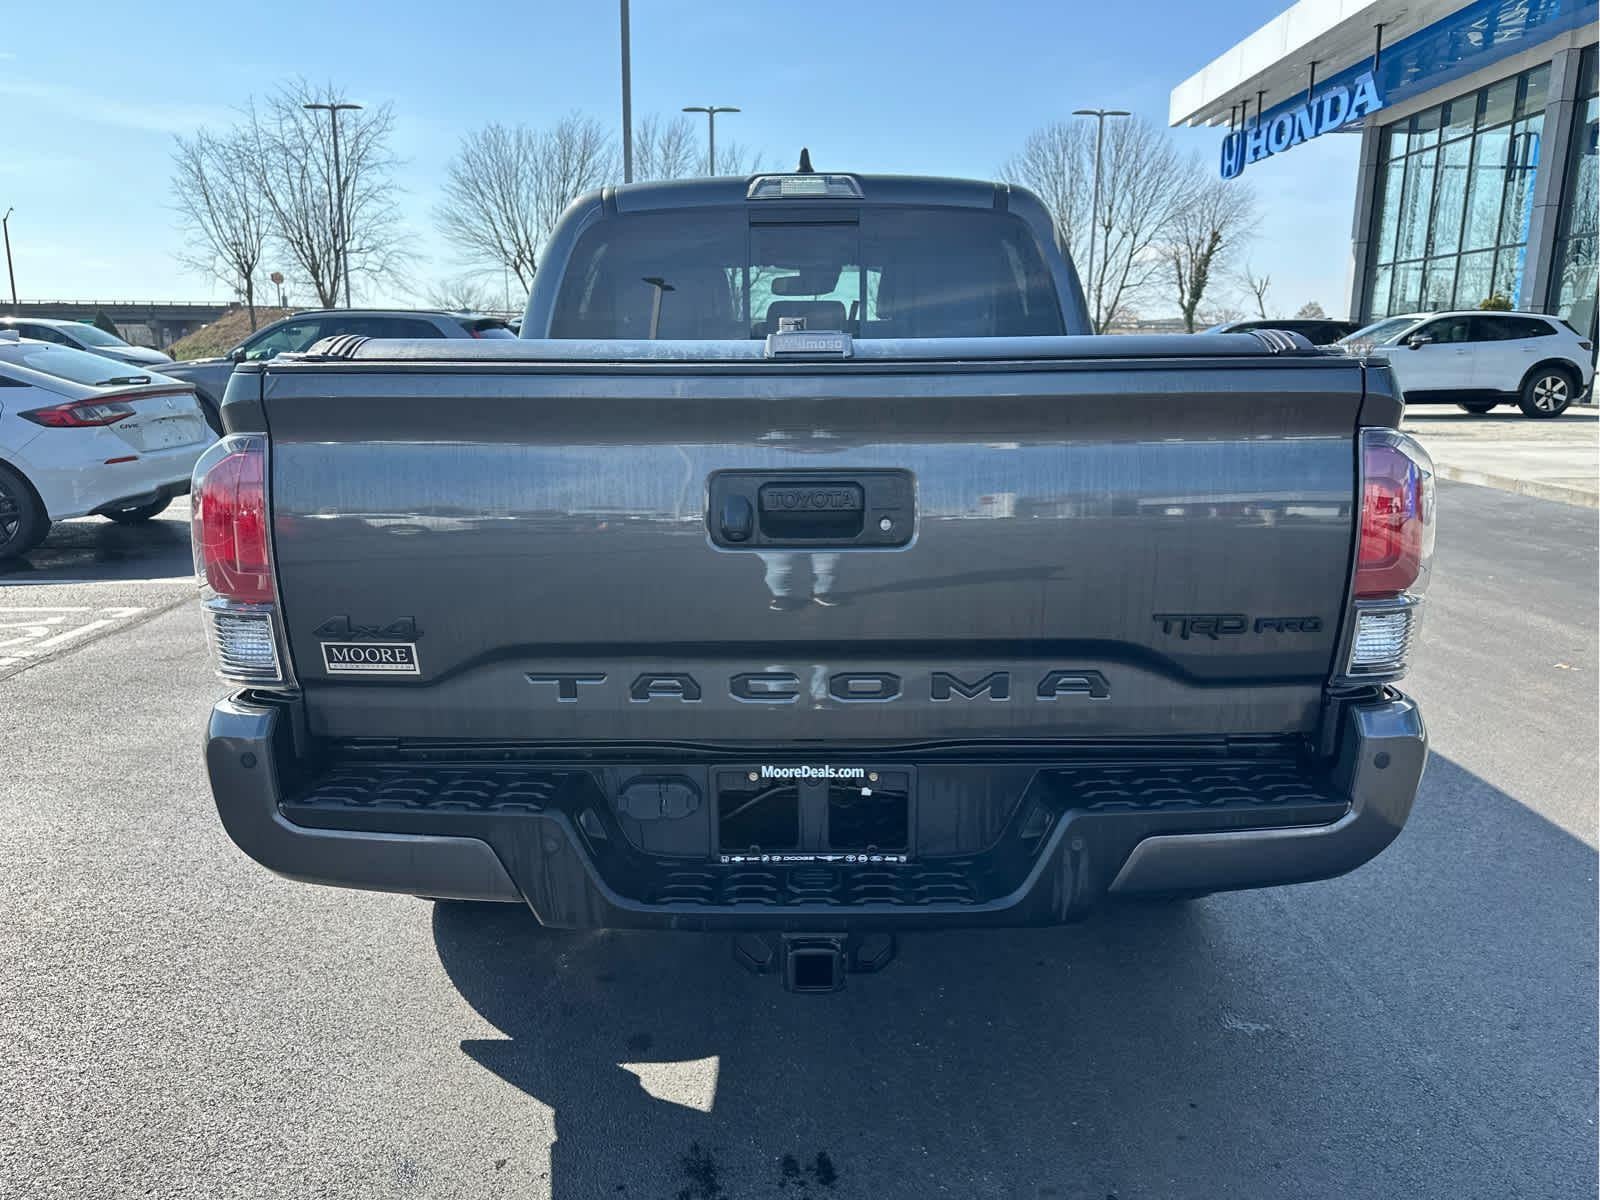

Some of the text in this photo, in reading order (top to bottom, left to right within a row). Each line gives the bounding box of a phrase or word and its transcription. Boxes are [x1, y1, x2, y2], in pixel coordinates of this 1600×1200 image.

[1245, 70, 1383, 164] HONDA
[768, 488, 857, 510] TOYOTA
[1152, 613, 1323, 641] TRD PRO
[331, 647, 409, 663] MOORE
[523, 669, 1111, 704] TACOMA
[761, 764, 865, 779] MooreDeals.com
